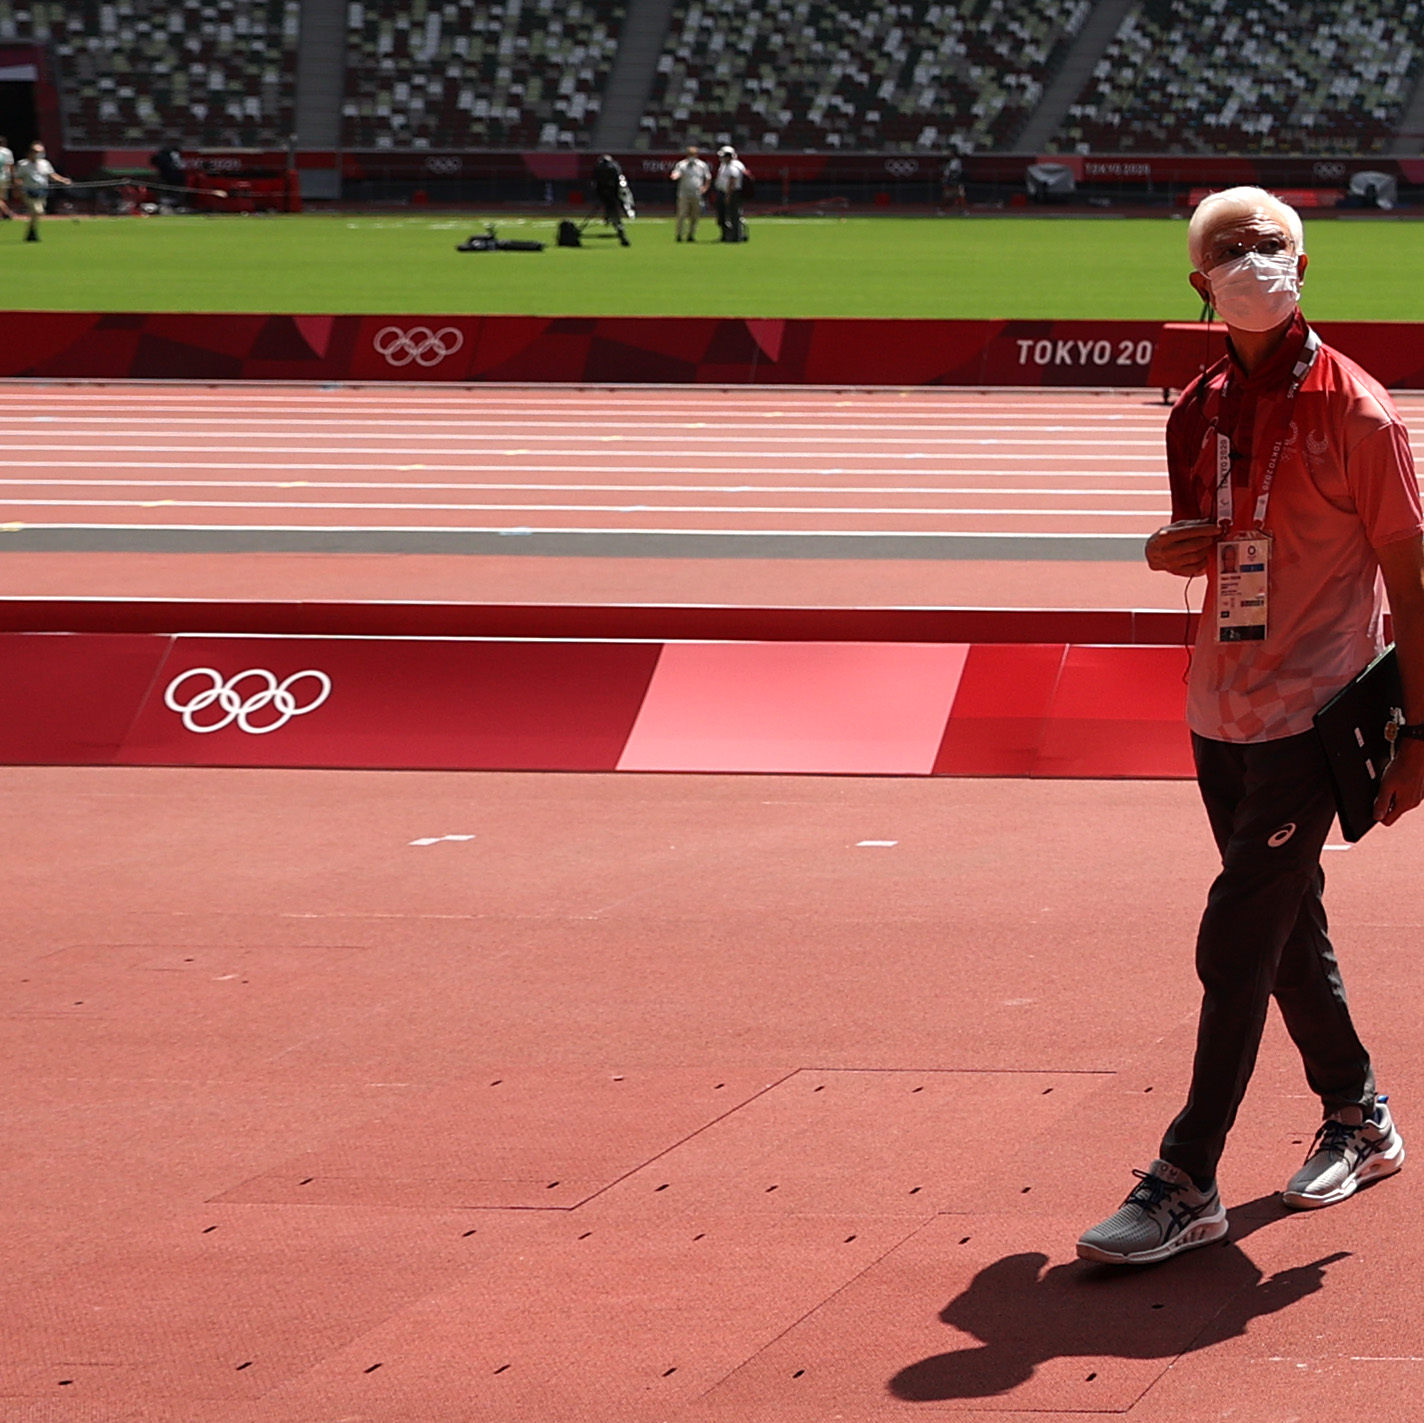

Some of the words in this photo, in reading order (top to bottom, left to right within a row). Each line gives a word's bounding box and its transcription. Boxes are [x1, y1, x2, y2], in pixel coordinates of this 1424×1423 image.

[1017, 339, 1112, 366] TOKYO
[1116, 340, 1158, 366] 20
[1268, 441, 1282, 469] TOKYO
[1262, 469, 1274, 491] 2020
